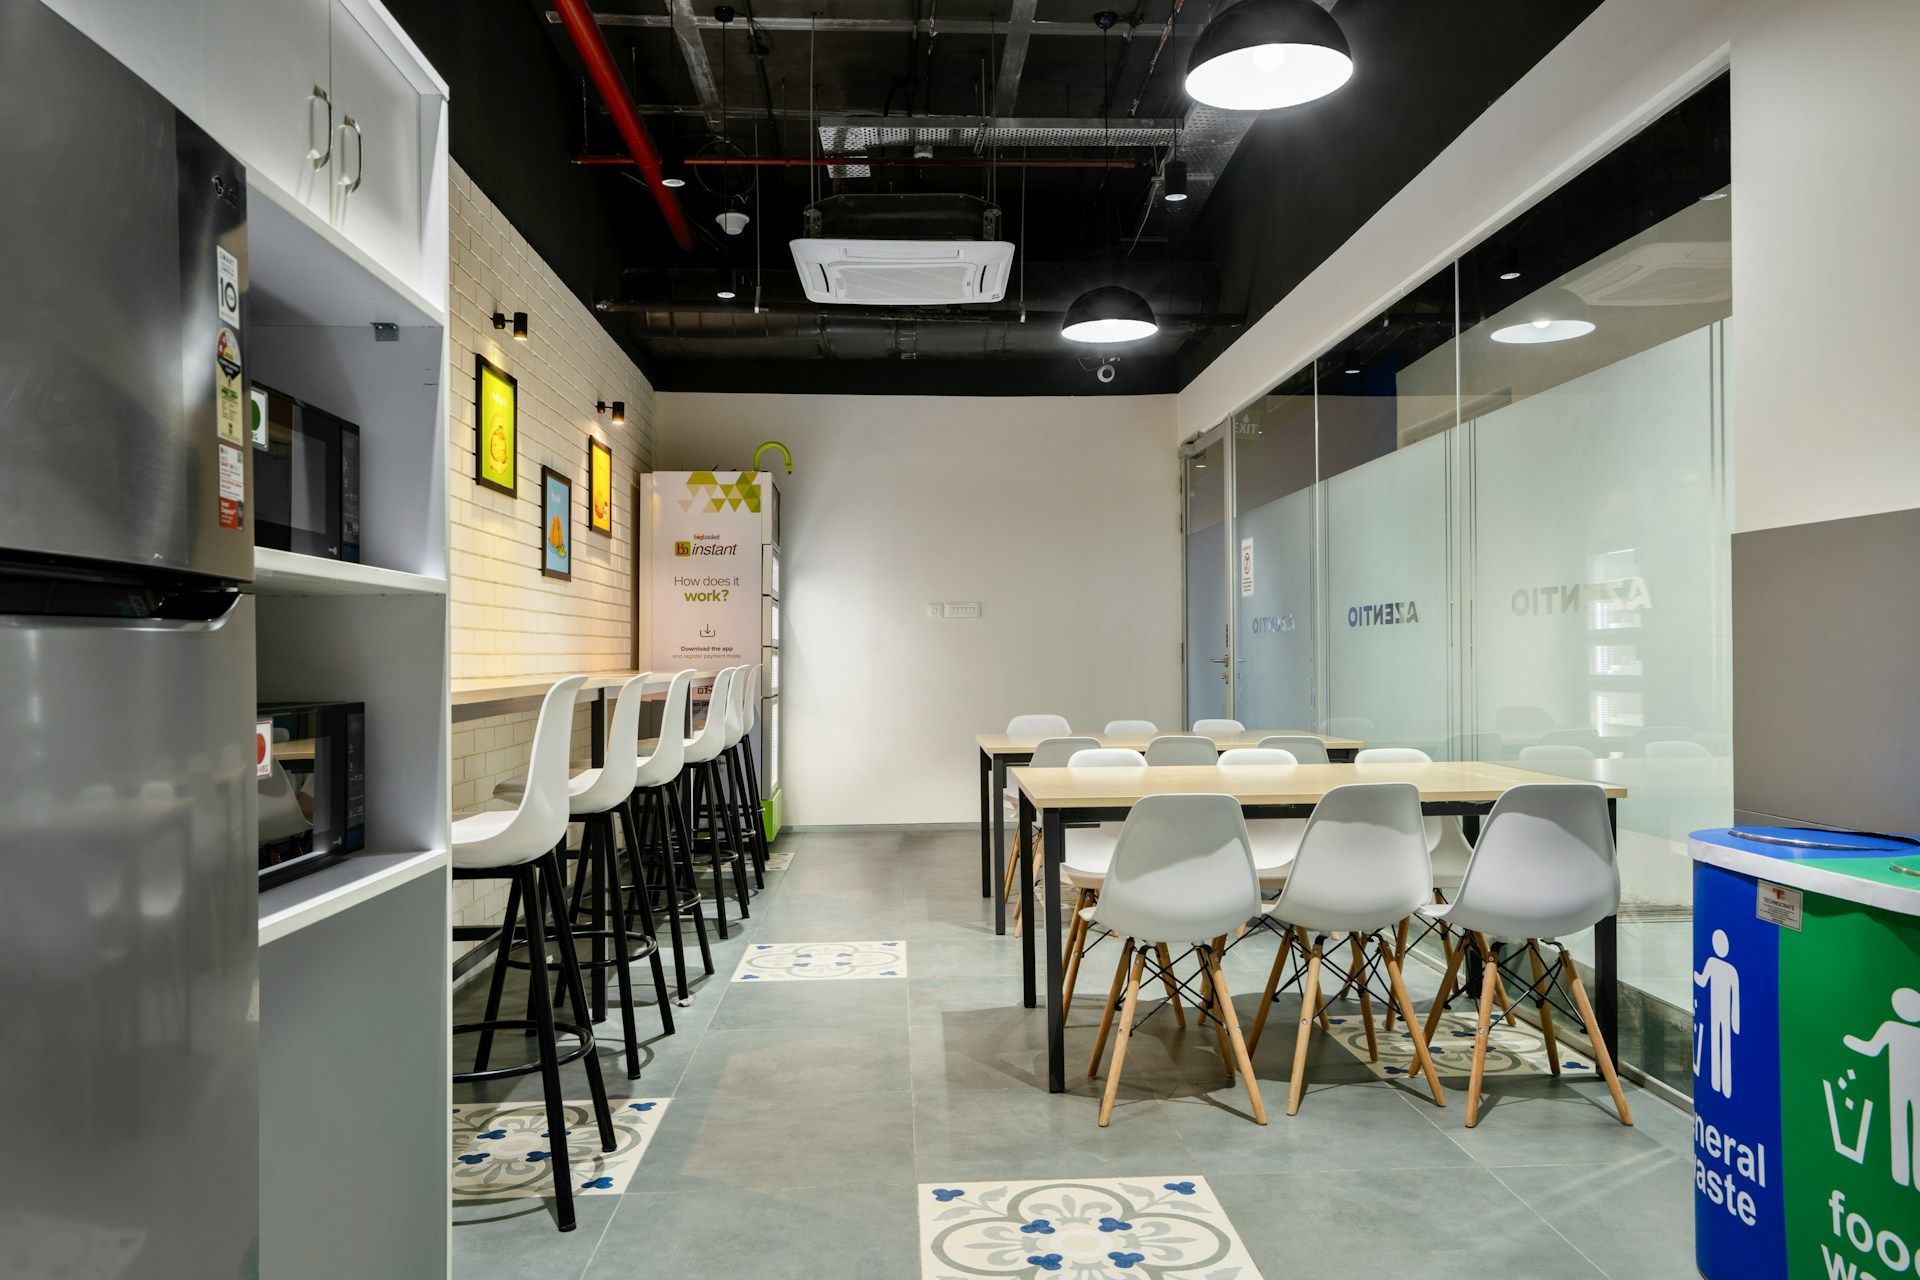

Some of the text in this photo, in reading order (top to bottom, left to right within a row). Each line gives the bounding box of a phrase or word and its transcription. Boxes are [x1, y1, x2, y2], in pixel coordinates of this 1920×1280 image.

[1234, 422, 1258, 435] EXIT
[691, 543, 738, 556] instant
[674, 576, 740, 587] How does it
[684, 589, 729, 602] work?
[1694, 1111, 1766, 1189] neral
[1694, 1154, 1758, 1228] aste
[1828, 1189, 1920, 1280] foo
